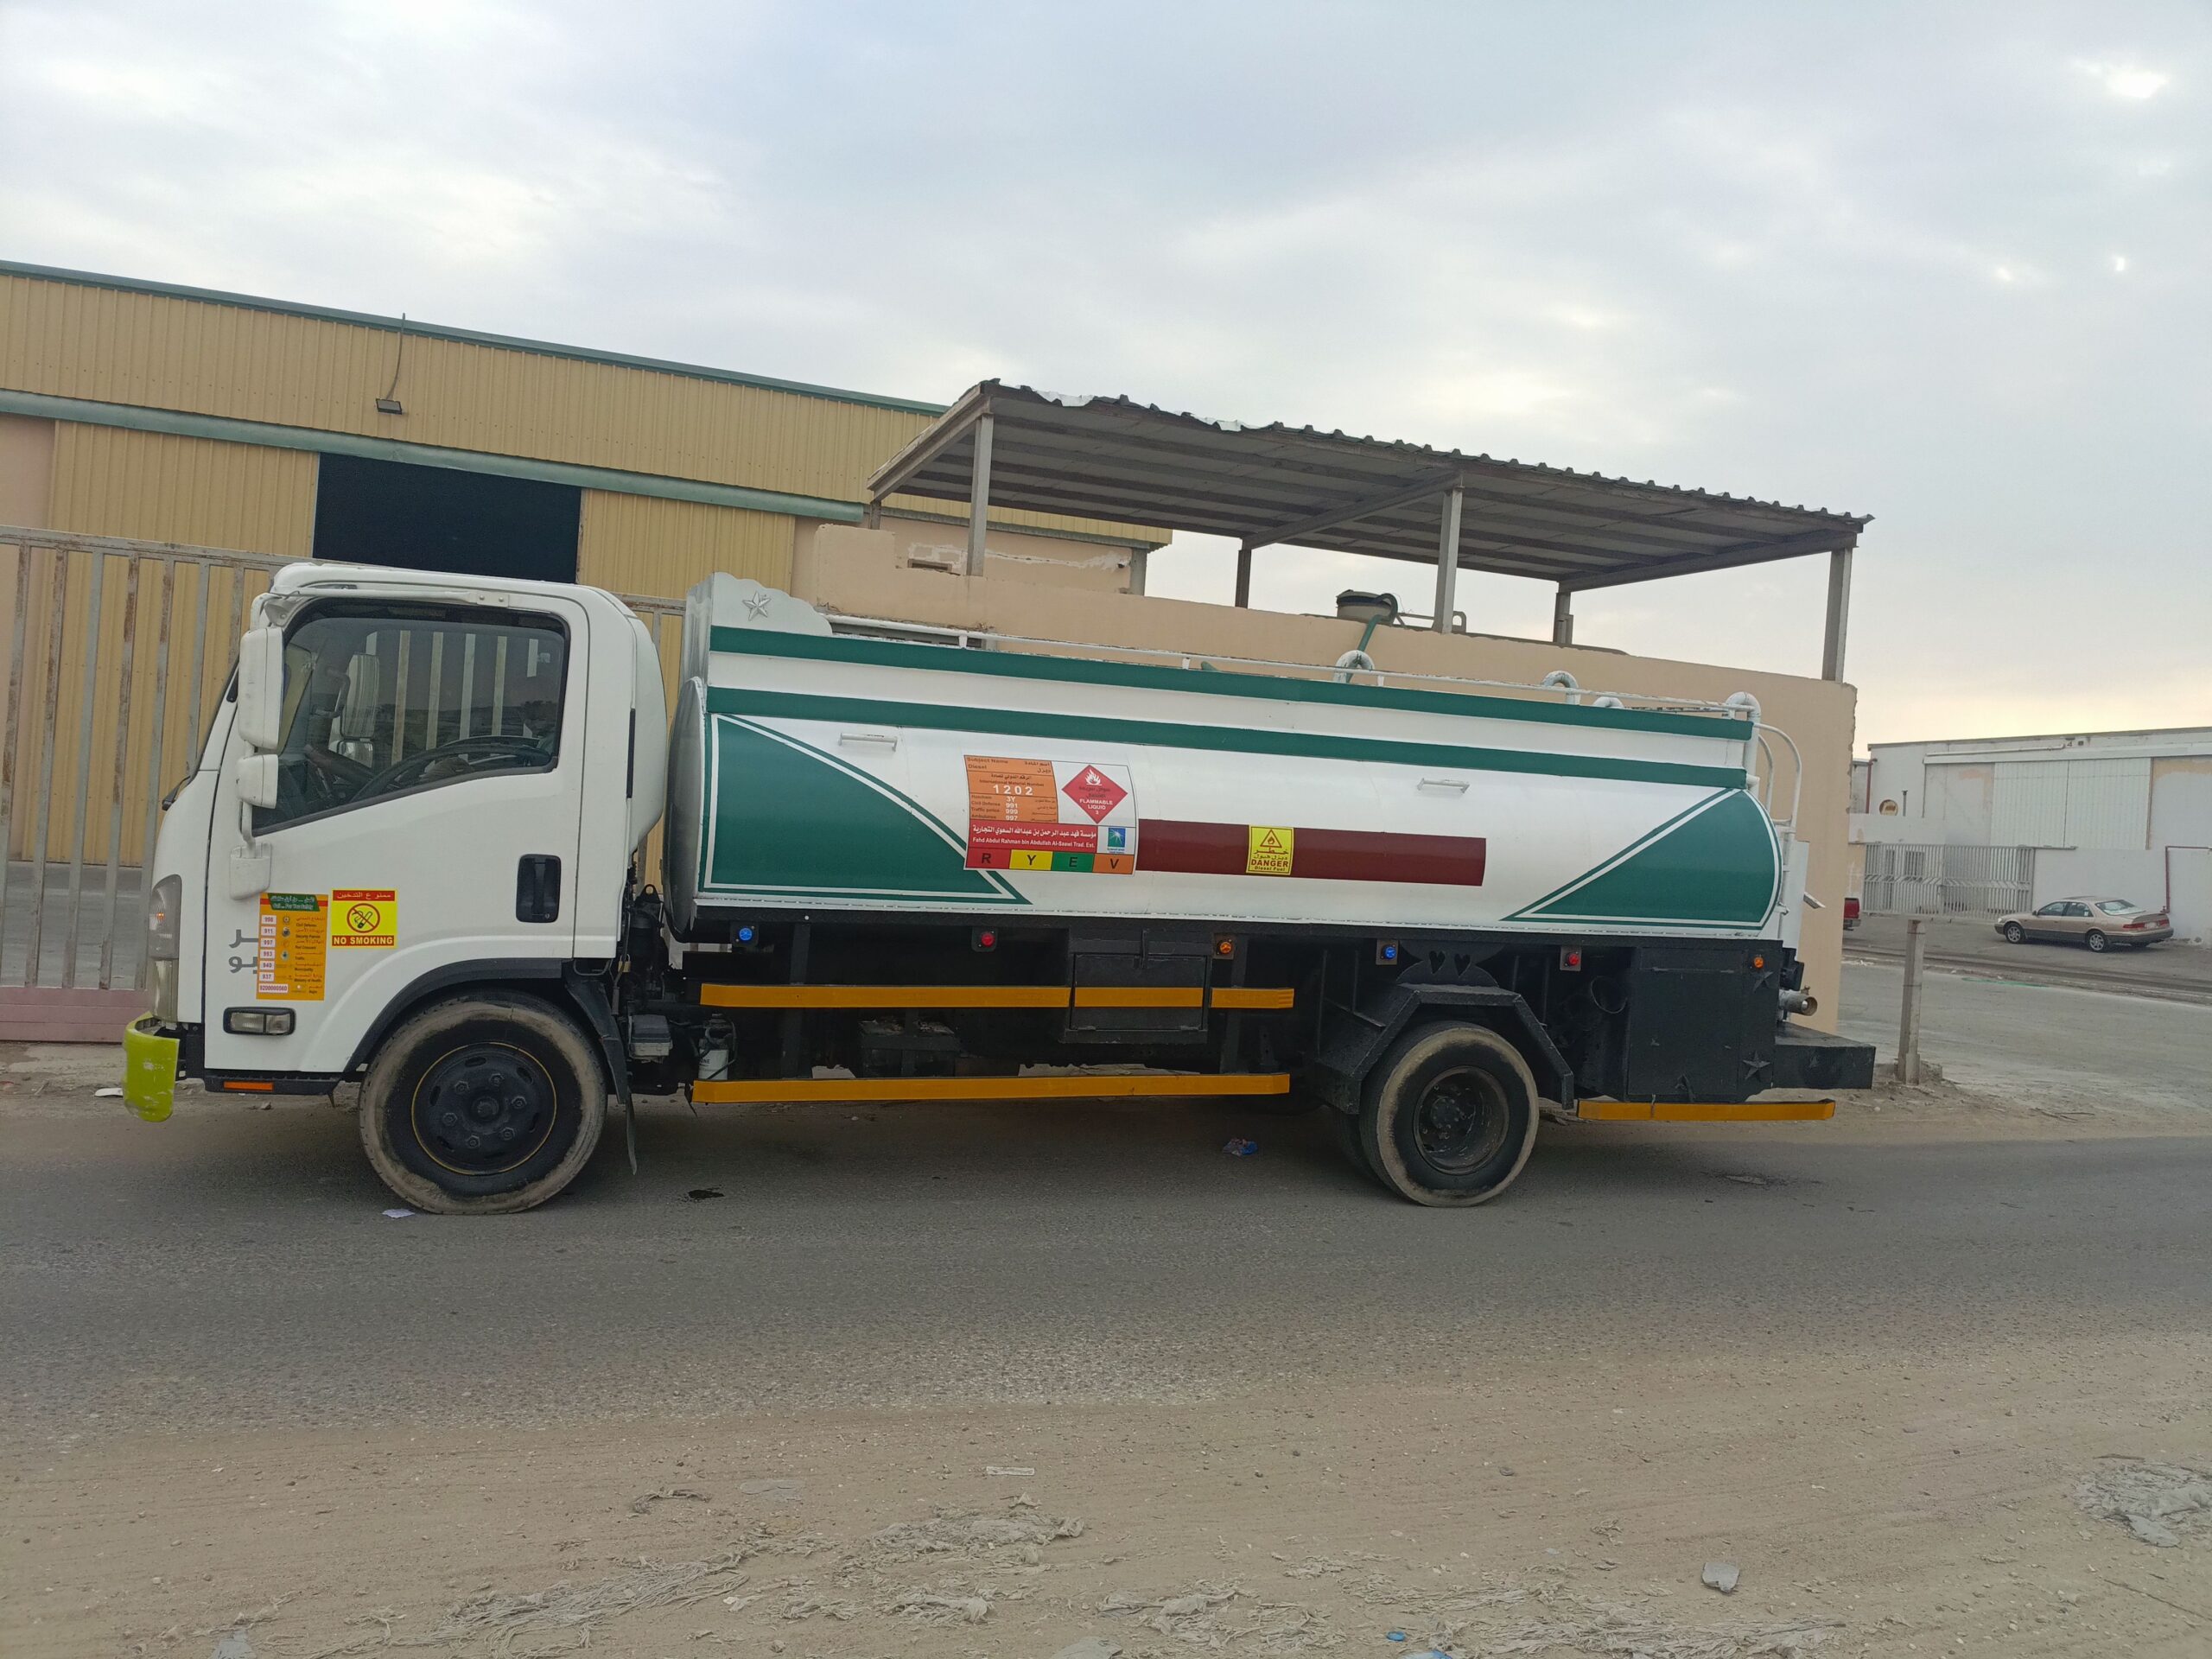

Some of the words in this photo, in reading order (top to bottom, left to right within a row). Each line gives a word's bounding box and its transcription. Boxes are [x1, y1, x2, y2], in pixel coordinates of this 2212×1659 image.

[1070, 830, 1080, 838] فهد
[982, 853, 991, 864] R
[1027, 855, 1036, 865] Y
[1069, 856, 1077, 867] E
[1110, 858, 1119, 868] V
[1251, 859, 1288, 868] DANGER
